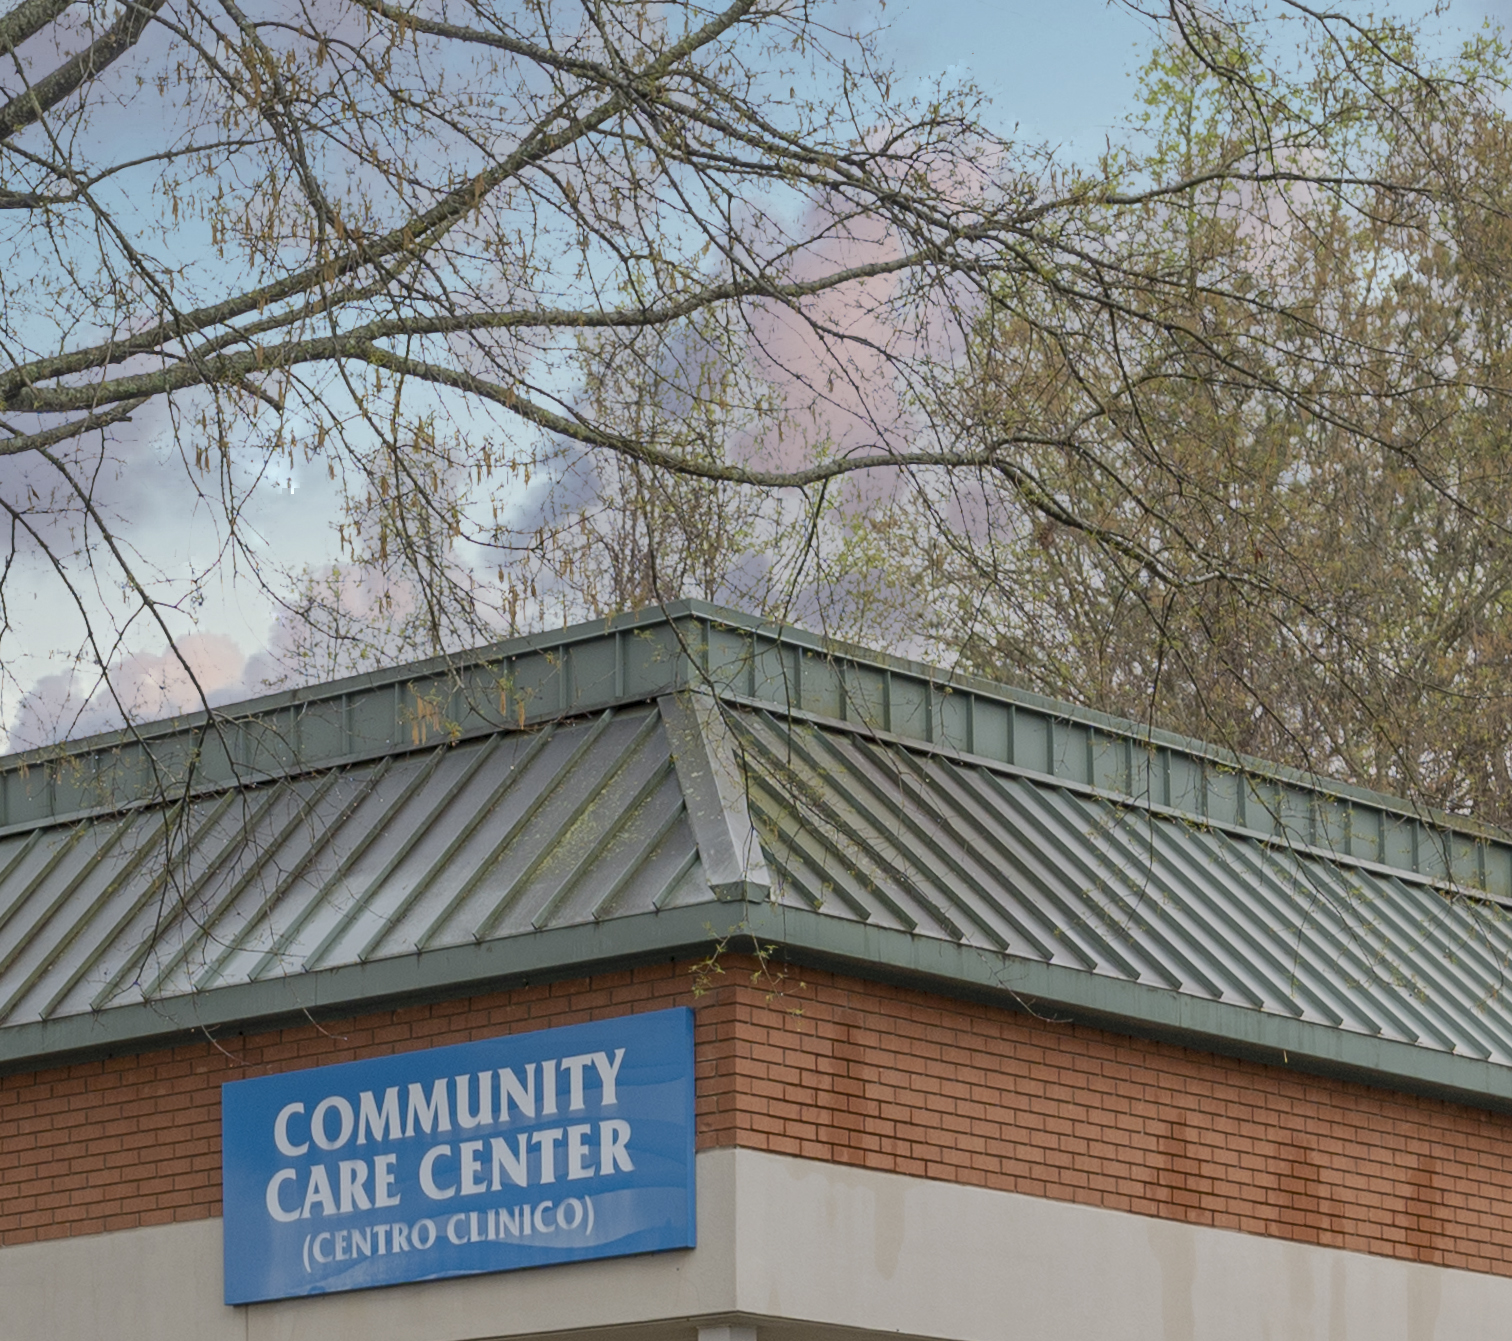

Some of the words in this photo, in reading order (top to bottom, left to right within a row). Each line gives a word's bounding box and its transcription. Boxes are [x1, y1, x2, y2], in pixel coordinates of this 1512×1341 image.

[275, 1048, 625, 1157] COMMUNITY
[266, 1153, 401, 1223] CARE
[419, 1119, 635, 1200] CENTER
[302, 1217, 437, 1273] (CENTRO
[447, 1195, 595, 1246] CLINICO)
